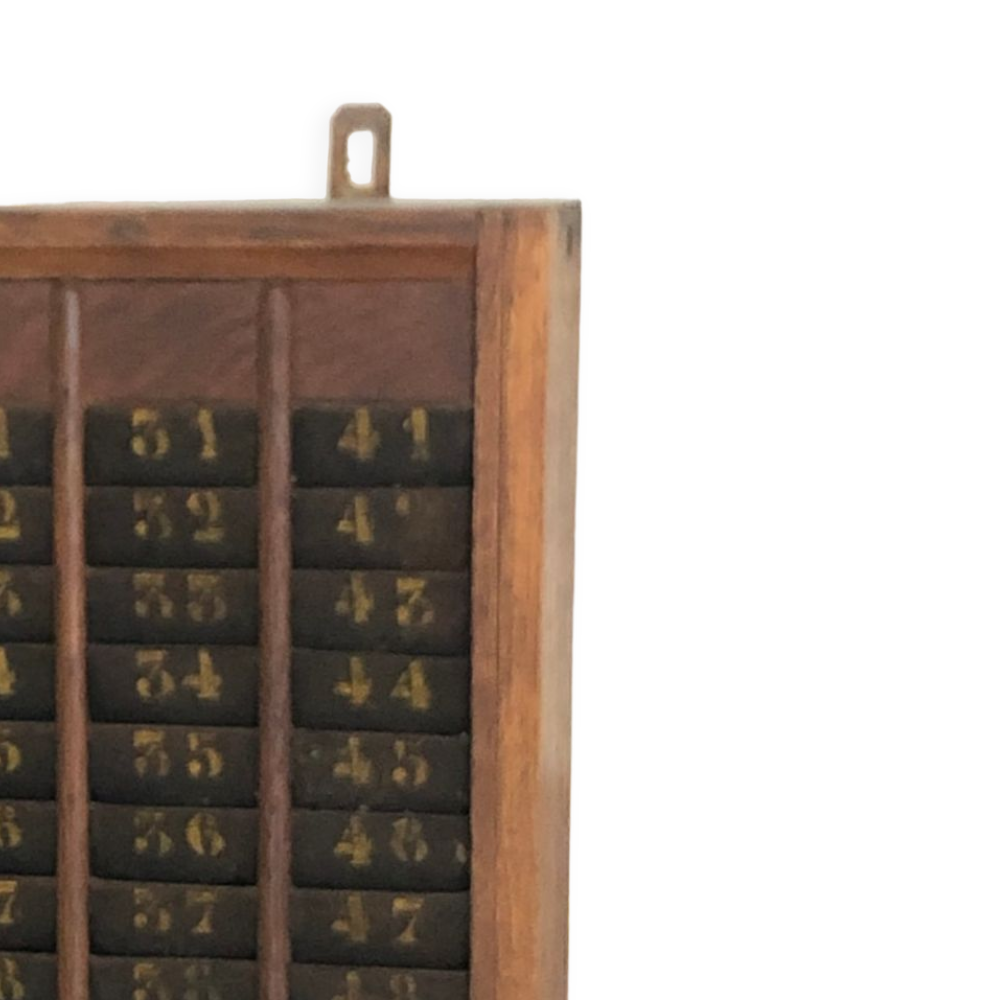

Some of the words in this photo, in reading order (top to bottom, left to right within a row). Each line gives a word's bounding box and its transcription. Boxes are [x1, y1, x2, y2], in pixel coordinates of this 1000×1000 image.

[130, 408, 218, 462] 31
[337, 407, 429, 463] 41
[132, 491, 224, 543] 32
[335, 573, 434, 627] 43
[134, 647, 224, 702] 34
[333, 656, 433, 710] 44
[132, 729, 224, 779] 35
[332, 736, 432, 785] 45
[133, 812, 226, 858] 36
[331, 893, 425, 944] 47
